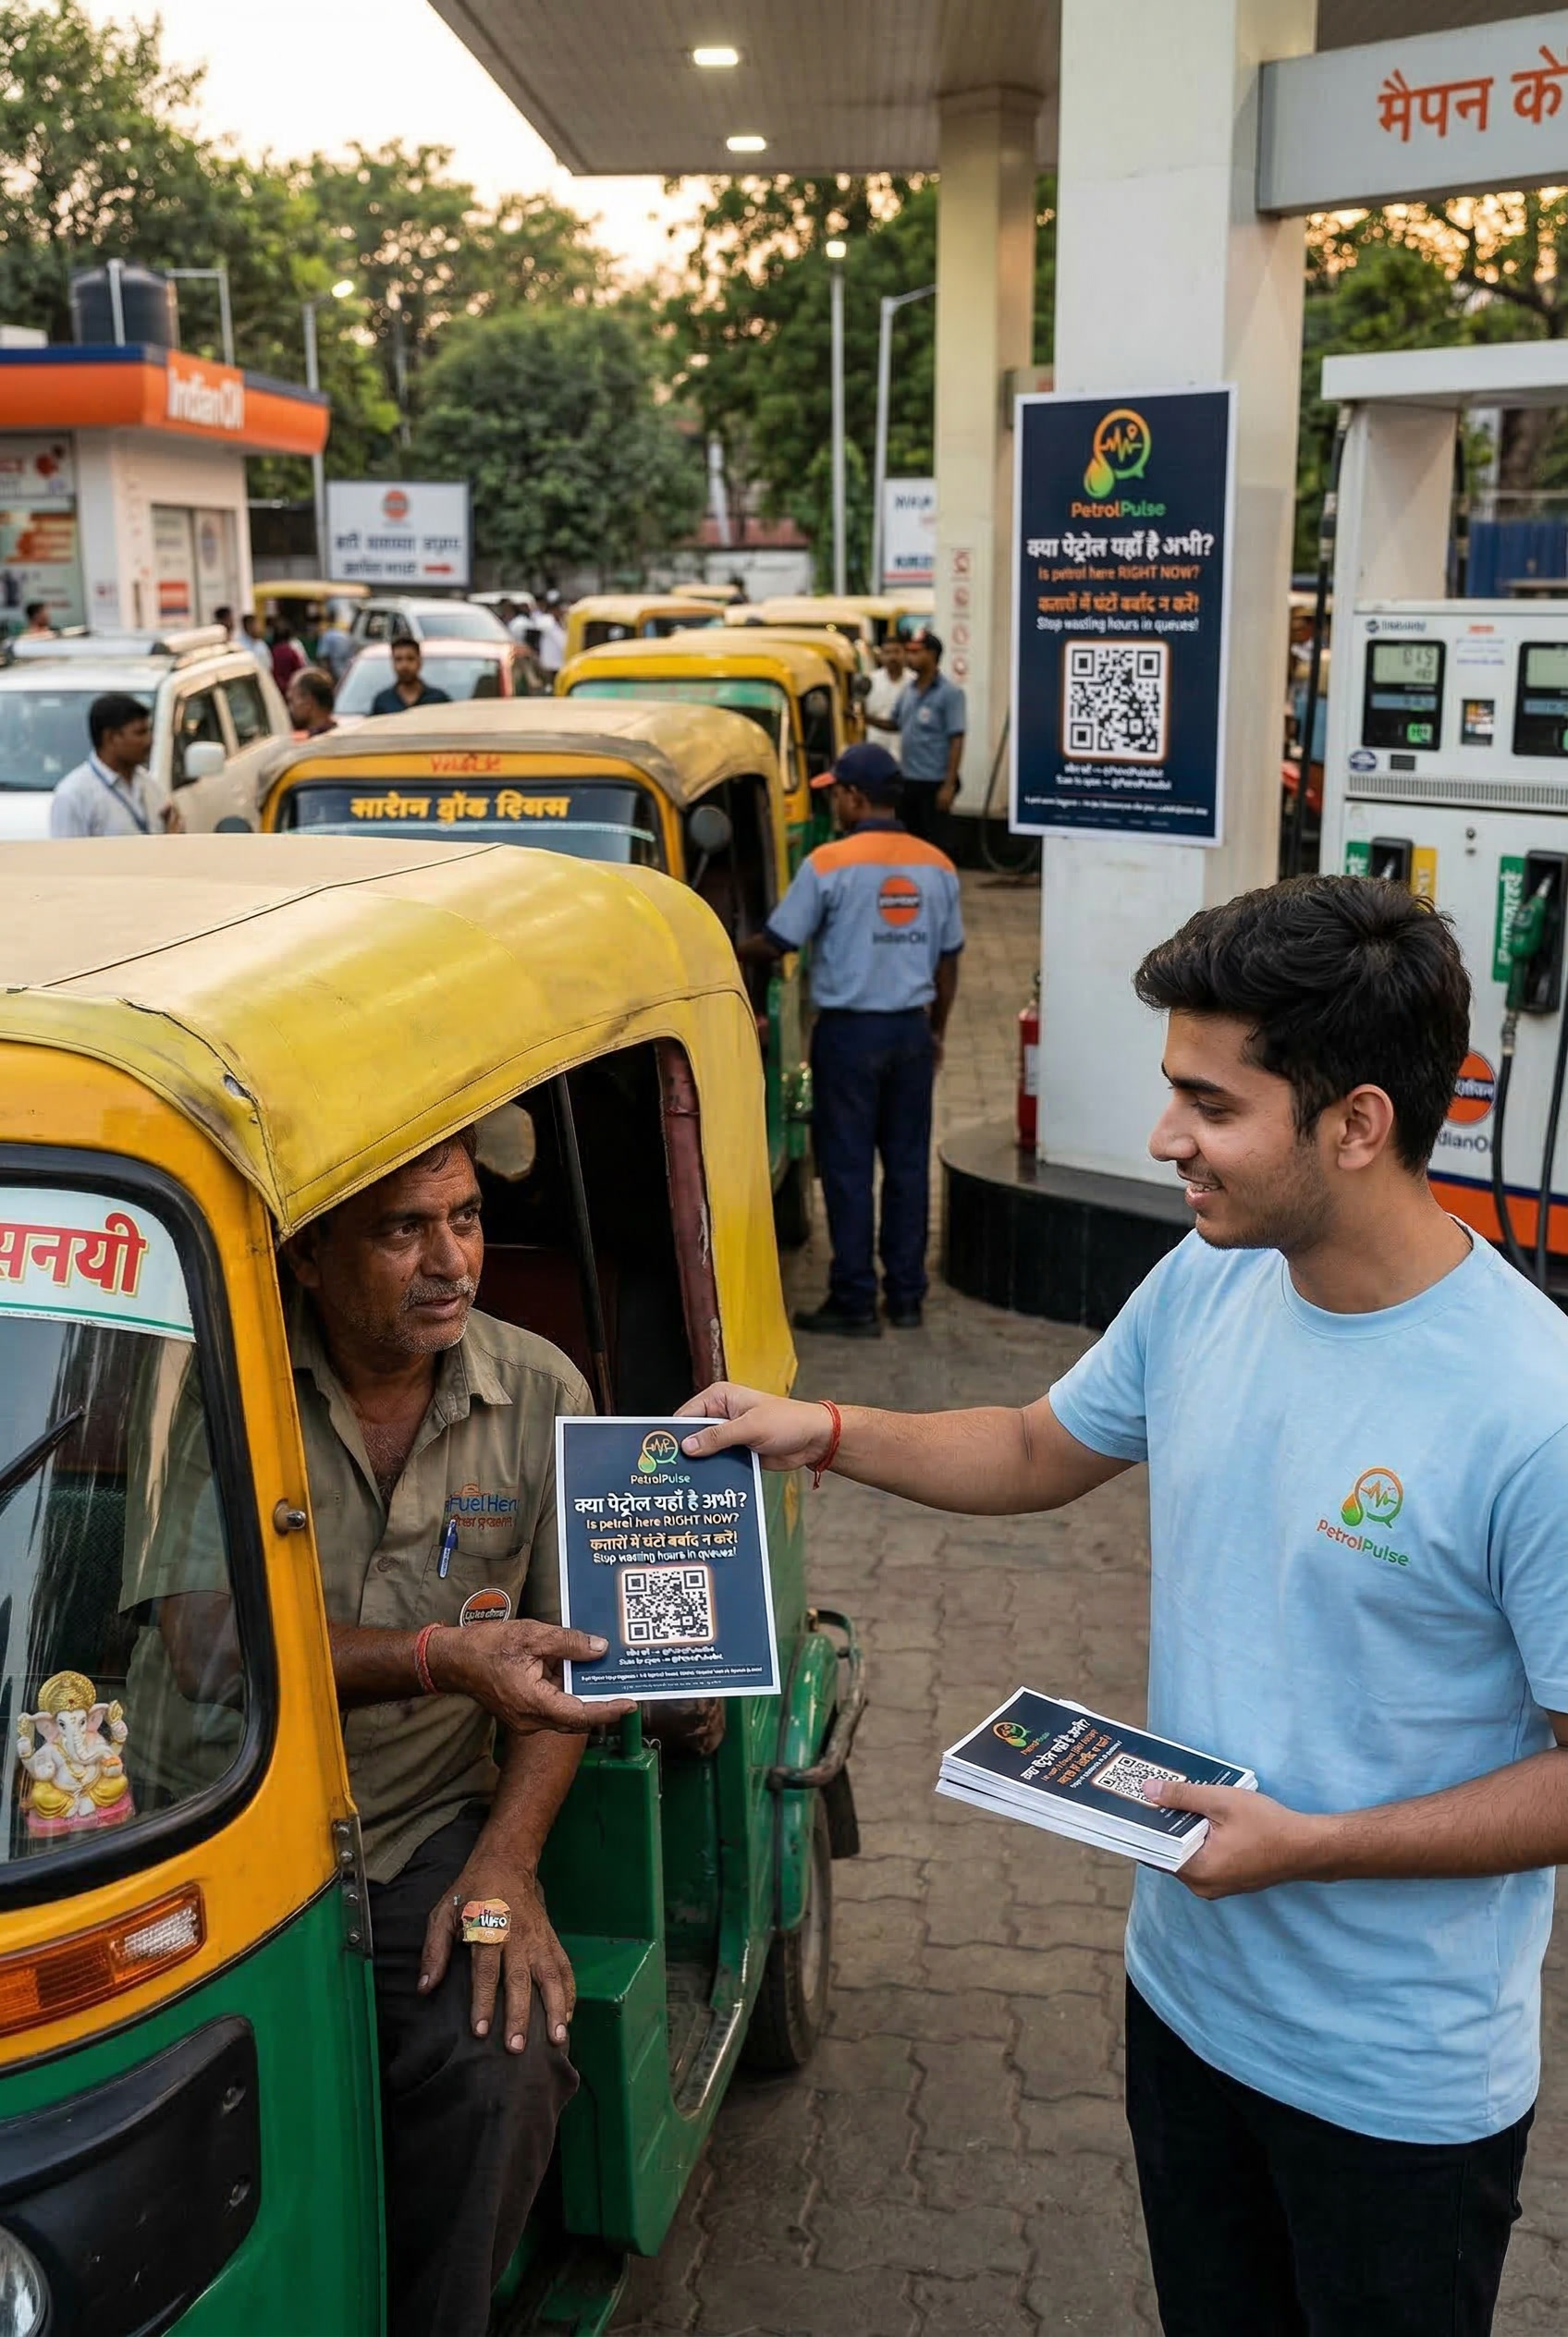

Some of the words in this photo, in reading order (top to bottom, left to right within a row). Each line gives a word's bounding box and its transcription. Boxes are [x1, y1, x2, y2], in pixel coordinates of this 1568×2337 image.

[1071, 500, 1167, 518] PetrolPulse
[1027, 538, 1059, 557] क्या
[1062, 531, 1108, 562] पेट्रोल
[1145, 530, 1159, 561] है
[1118, 565, 1158, 580] RIGHT
[1160, 565, 1200, 580] NOW?
[574, 1498, 603, 1514] क्या
[607, 1492, 651, 1517] पेट्रोल
[654, 1488, 683, 1512] यहाँ
[687, 1489, 699, 1511] है
[702, 1488, 748, 1511] अभी?
[586, 1519, 597, 1530] Is
[635, 1516, 661, 1528] here
[663, 1514, 700, 1526] RIGHT
[703, 1512, 740, 1525] NOW?
[630, 1532, 642, 1549] में
[702, 1534, 711, 1547] न
[1317, 1519, 1409, 1566] PetrolPulse
[687, 1548, 697, 1560] in
